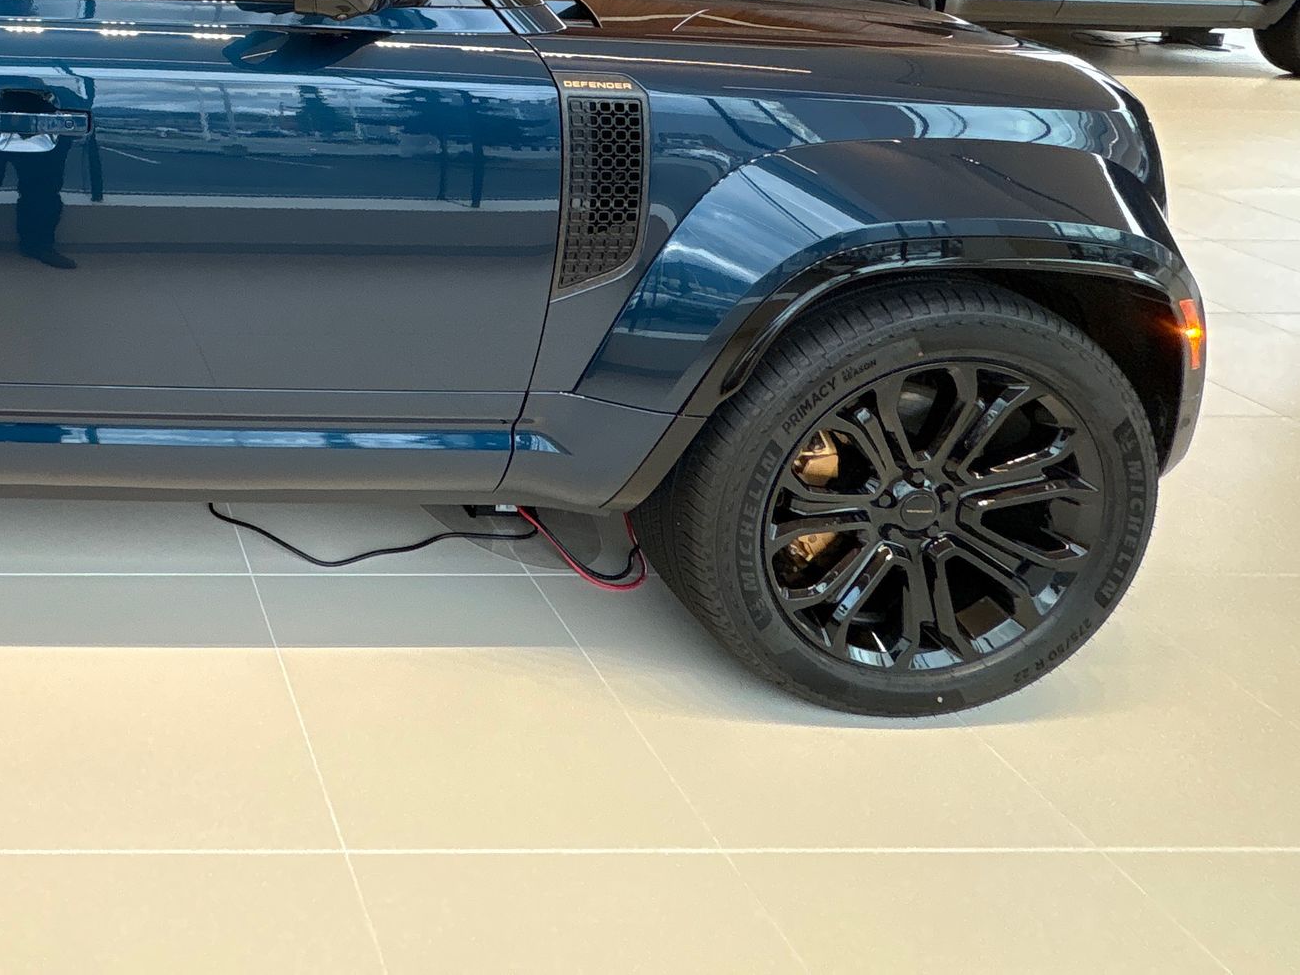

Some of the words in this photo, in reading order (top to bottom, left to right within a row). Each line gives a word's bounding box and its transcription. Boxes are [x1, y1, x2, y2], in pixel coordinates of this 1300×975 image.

[562, 79, 633, 91] DEFENDER
[781, 376, 837, 435] PRIMACY
[738, 449, 778, 592] MICHELIN
[1100, 459, 1146, 600] MICHELIN
